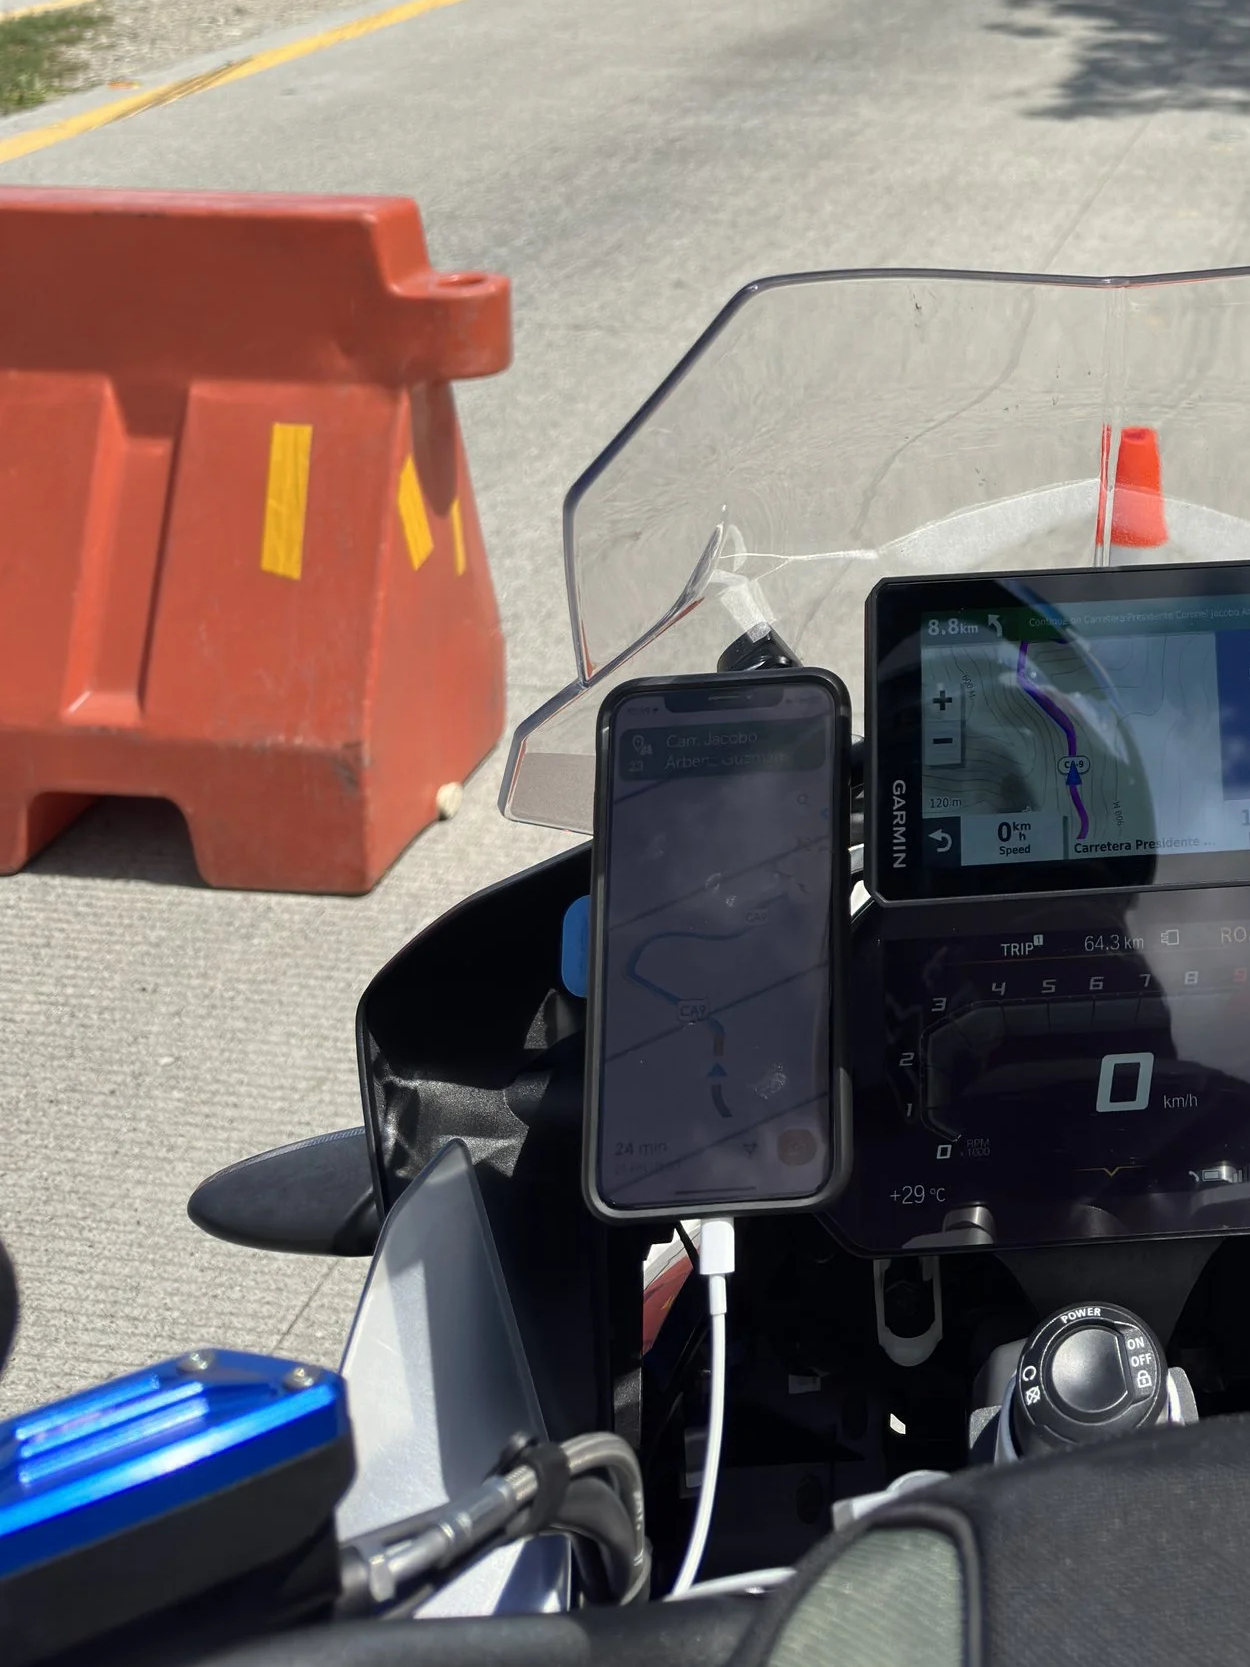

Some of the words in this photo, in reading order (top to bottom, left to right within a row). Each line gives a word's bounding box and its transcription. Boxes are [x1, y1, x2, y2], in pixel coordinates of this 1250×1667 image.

[929, 797, 950, 809] 120
[951, 797, 962, 807] m
[892, 779, 907, 869] GARMIN
[997, 821, 1012, 843] 0
[1012, 821, 1032, 831] km
[999, 844, 1031, 856] Speed
[1073, 841, 1132, 854] Carretera
[1135, 836, 1201, 850] Presidente
[1001, 941, 1034, 957] TRIP
[1083, 934, 1120, 952] 64.3
[1124, 936, 1144, 950] km
[991, 981, 1007, 996] 4
[1041, 978, 1057, 994] 5
[1089, 976, 1105, 991] 6
[1139, 973, 1151, 988] 7
[1184, 970, 1199, 985] 8
[1234, 966, 1248, 982] 9
[931, 997, 947, 1012] 3
[898, 1051, 915, 1067] 2
[1096, 1052, 1155, 1113] 0
[1163, 1093, 1198, 1109] km/h
[906, 1103, 913, 1118] 1
[966, 1137, 990, 1148] RPM
[936, 1144, 952, 1160] 0
[889, 1184, 925, 1205] +29
[1060, 1307, 1101, 1324] POWER
[1127, 1337, 1145, 1350] ON
[1130, 1352, 1152, 1368] OFF
